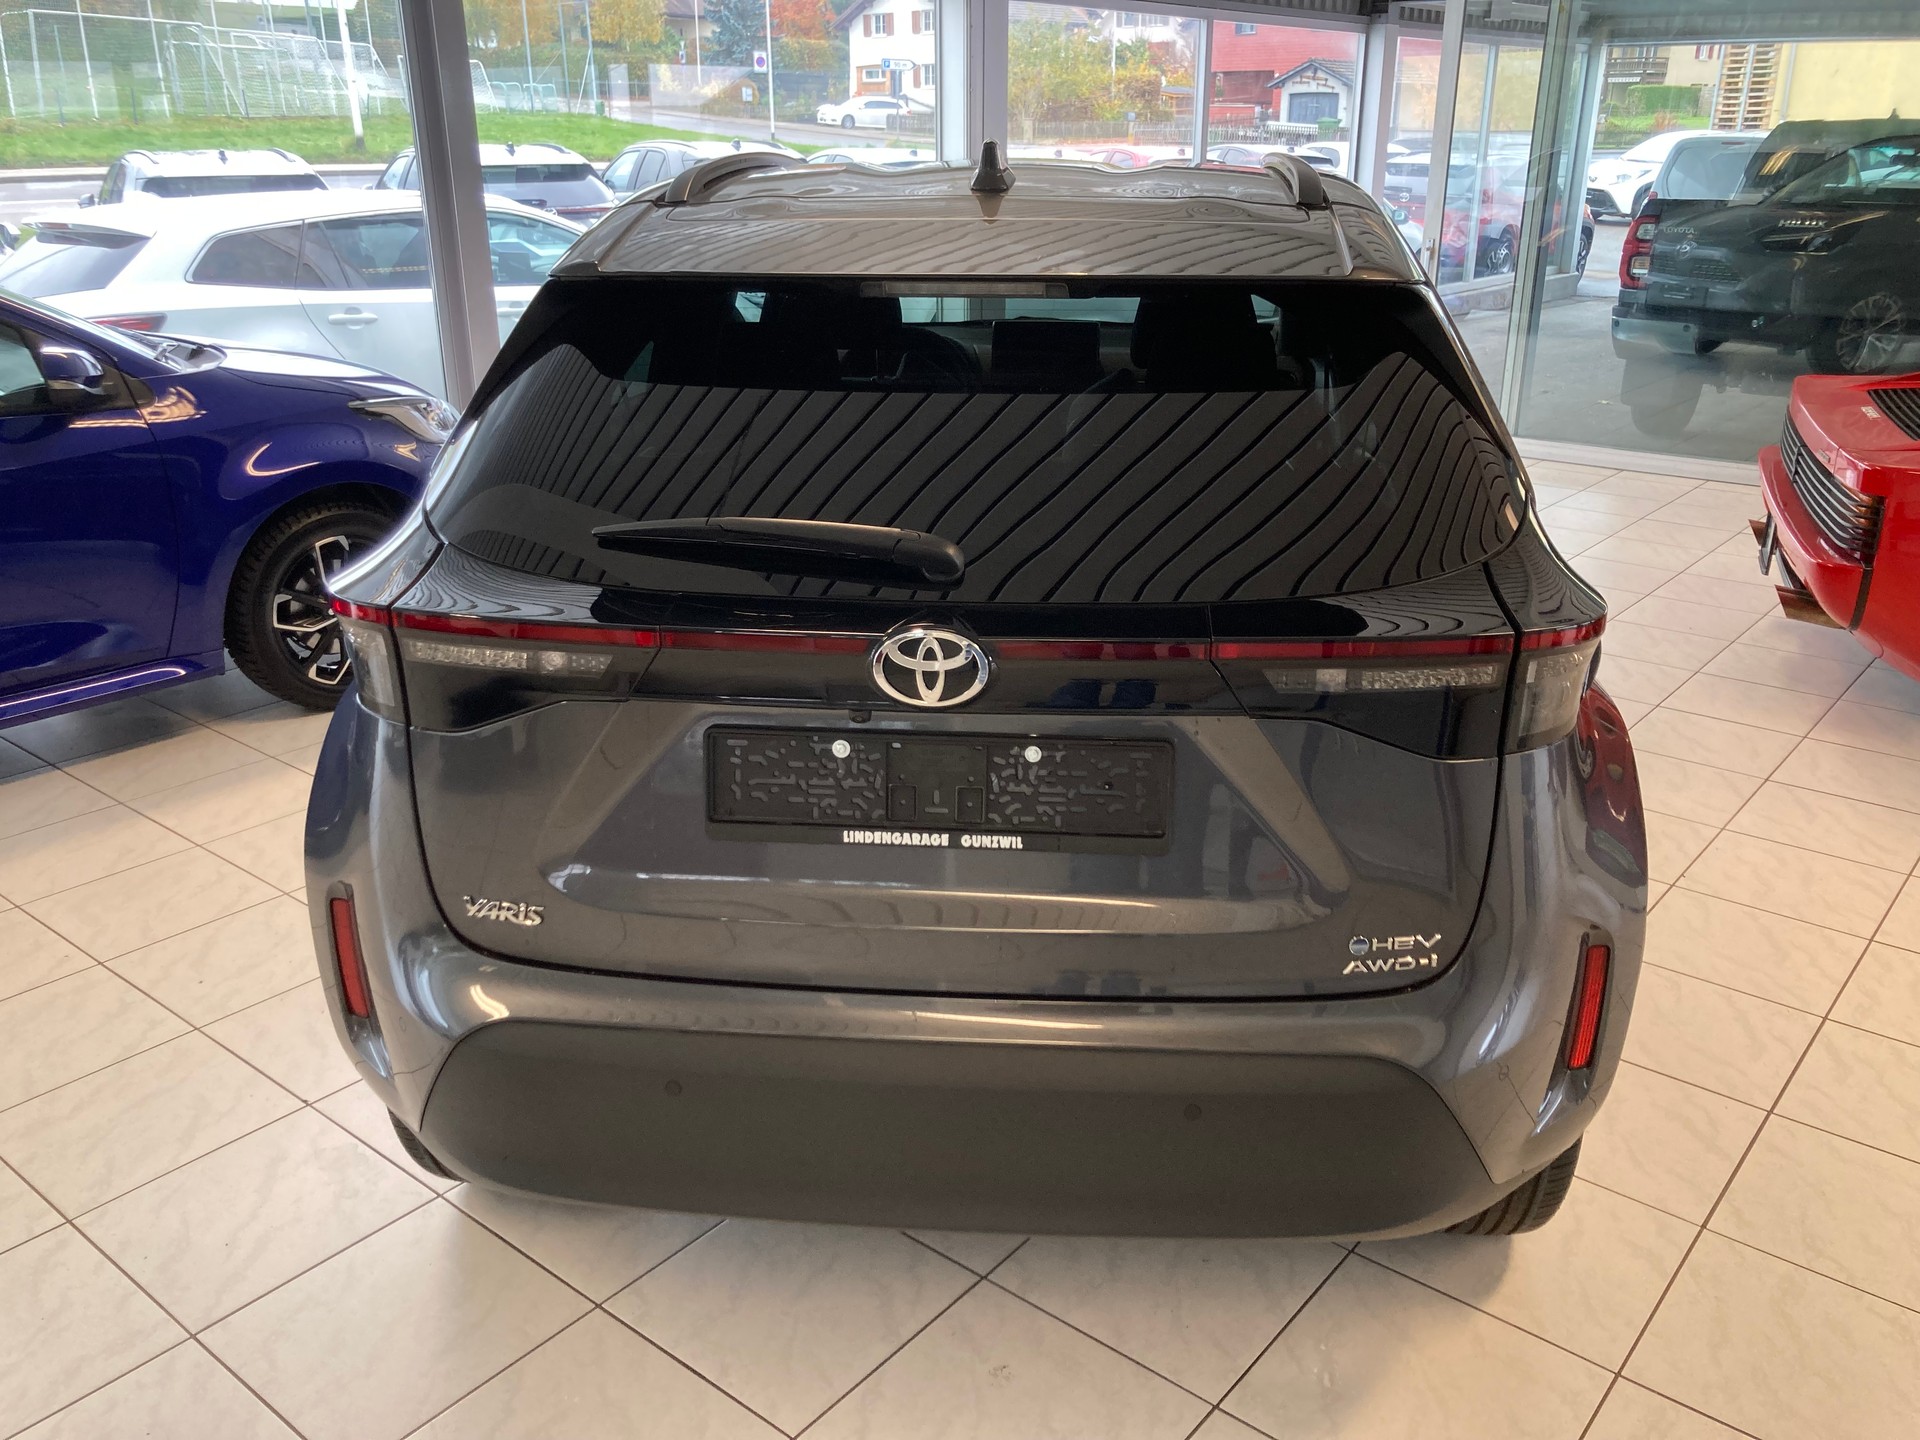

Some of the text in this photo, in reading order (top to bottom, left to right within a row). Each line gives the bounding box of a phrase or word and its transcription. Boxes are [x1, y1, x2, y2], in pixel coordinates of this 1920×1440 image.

[1664, 226, 1695, 234] TOYOTA
[843, 830, 1023, 849] LINDENGARAGE GUNZWIL
[1372, 933, 1442, 952] HEV
